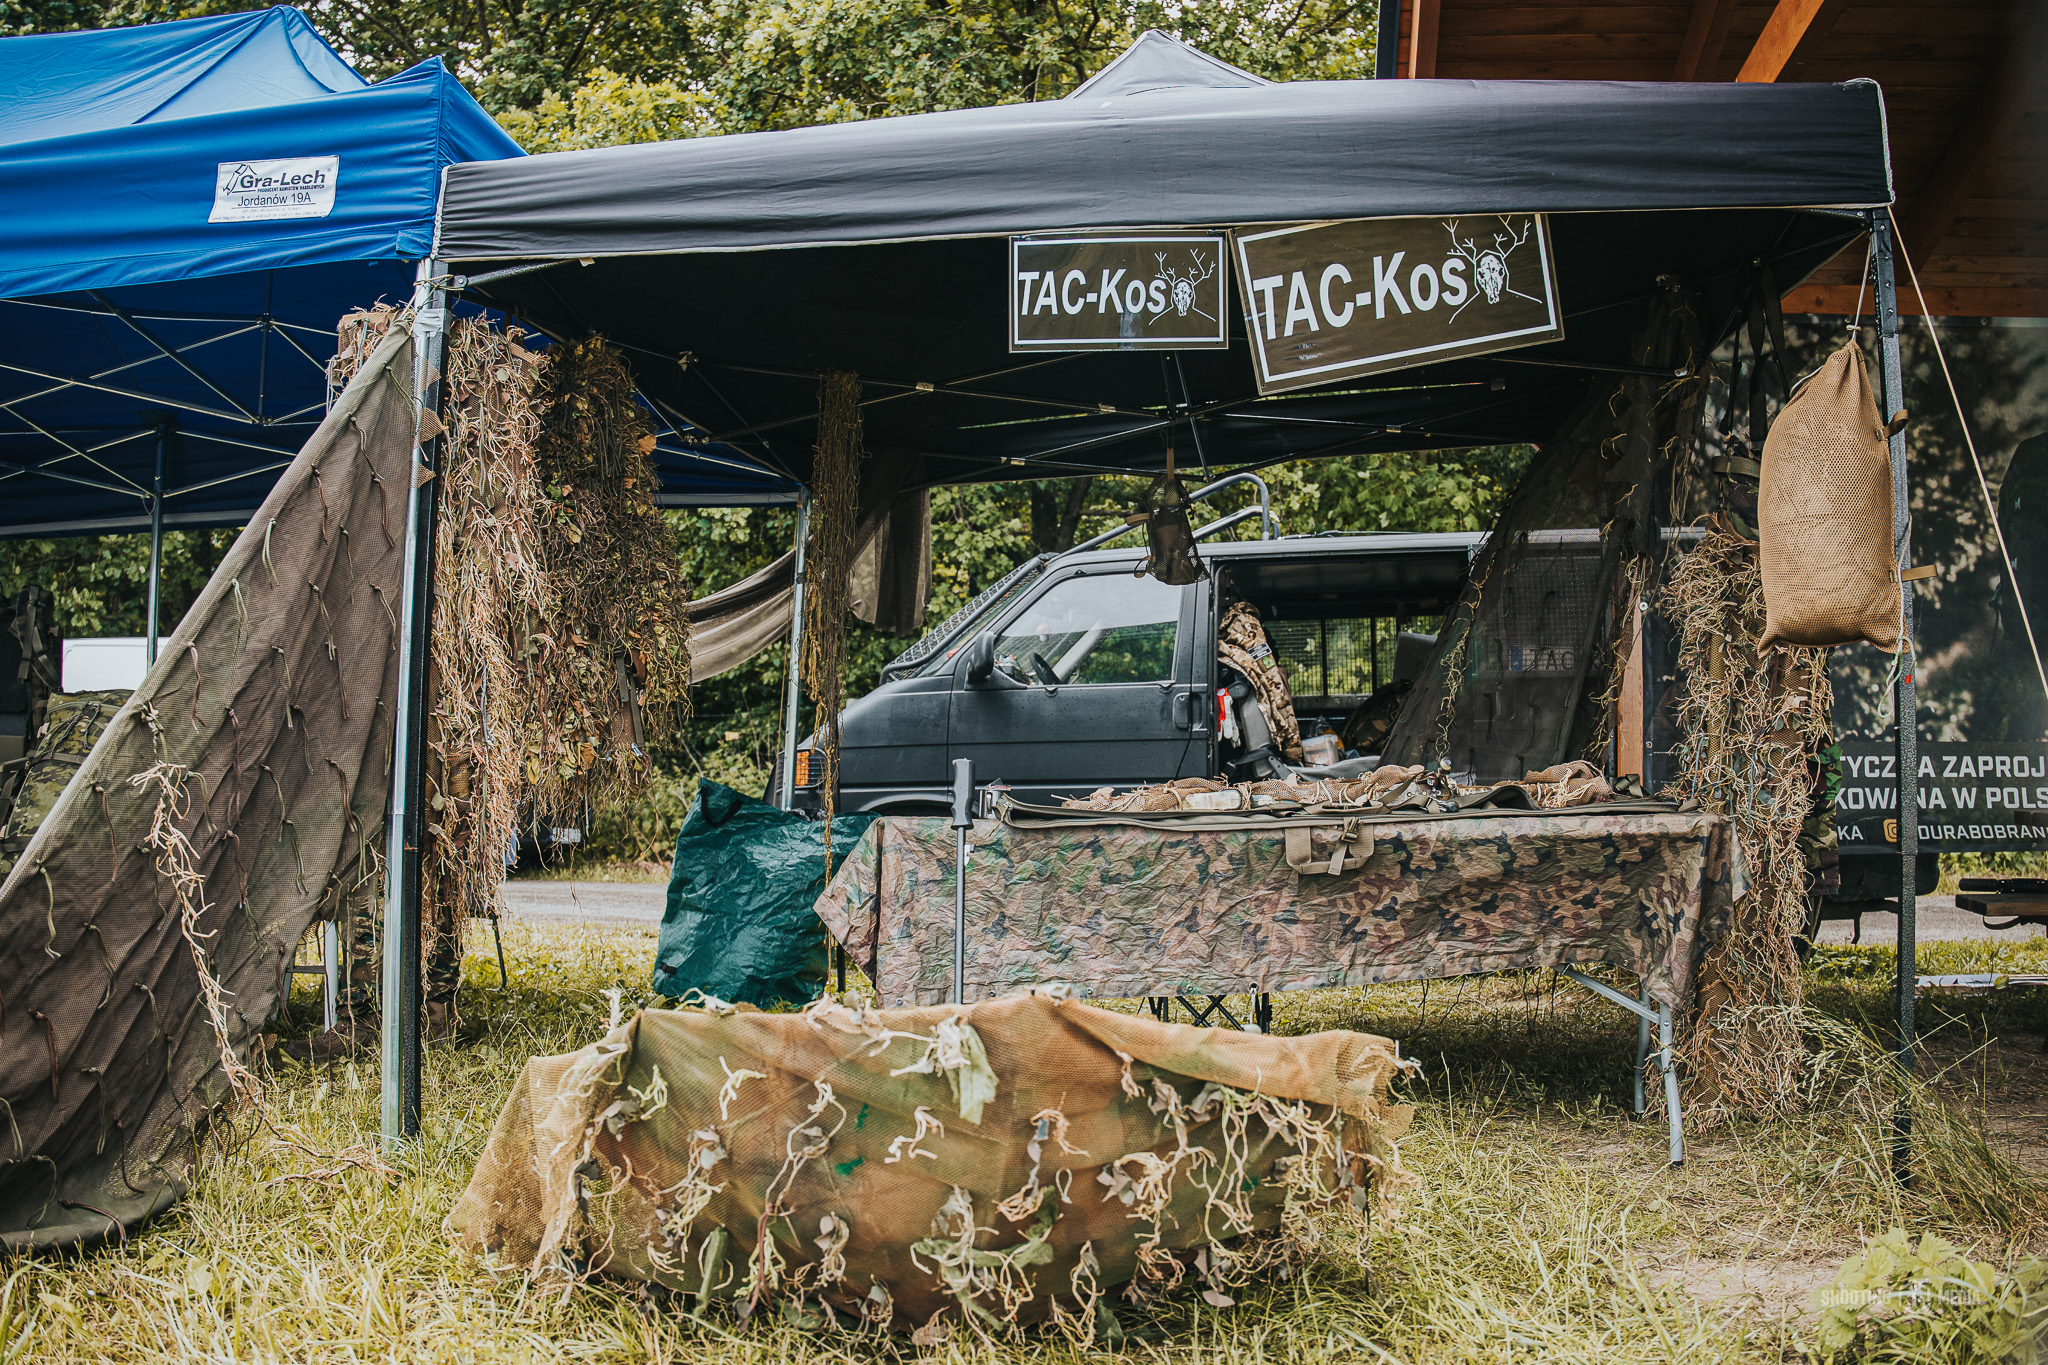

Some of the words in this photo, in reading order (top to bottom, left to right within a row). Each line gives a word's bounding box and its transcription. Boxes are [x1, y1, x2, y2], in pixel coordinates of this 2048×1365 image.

[240, 170, 326, 189] Gra-Lech
[237, 193, 288, 207] Jordanów
[291, 192, 312, 203] 19A
[1018, 269, 1167, 316] TAC-Kos
[1252, 251, 1469, 340] TAC-Kos
[1942, 755, 2046, 778] ZAPROJ
[1952, 787, 1977, 809] W
[1985, 787, 2048, 809] POLS
[1917, 824, 2048, 840] DURABOBRAN
